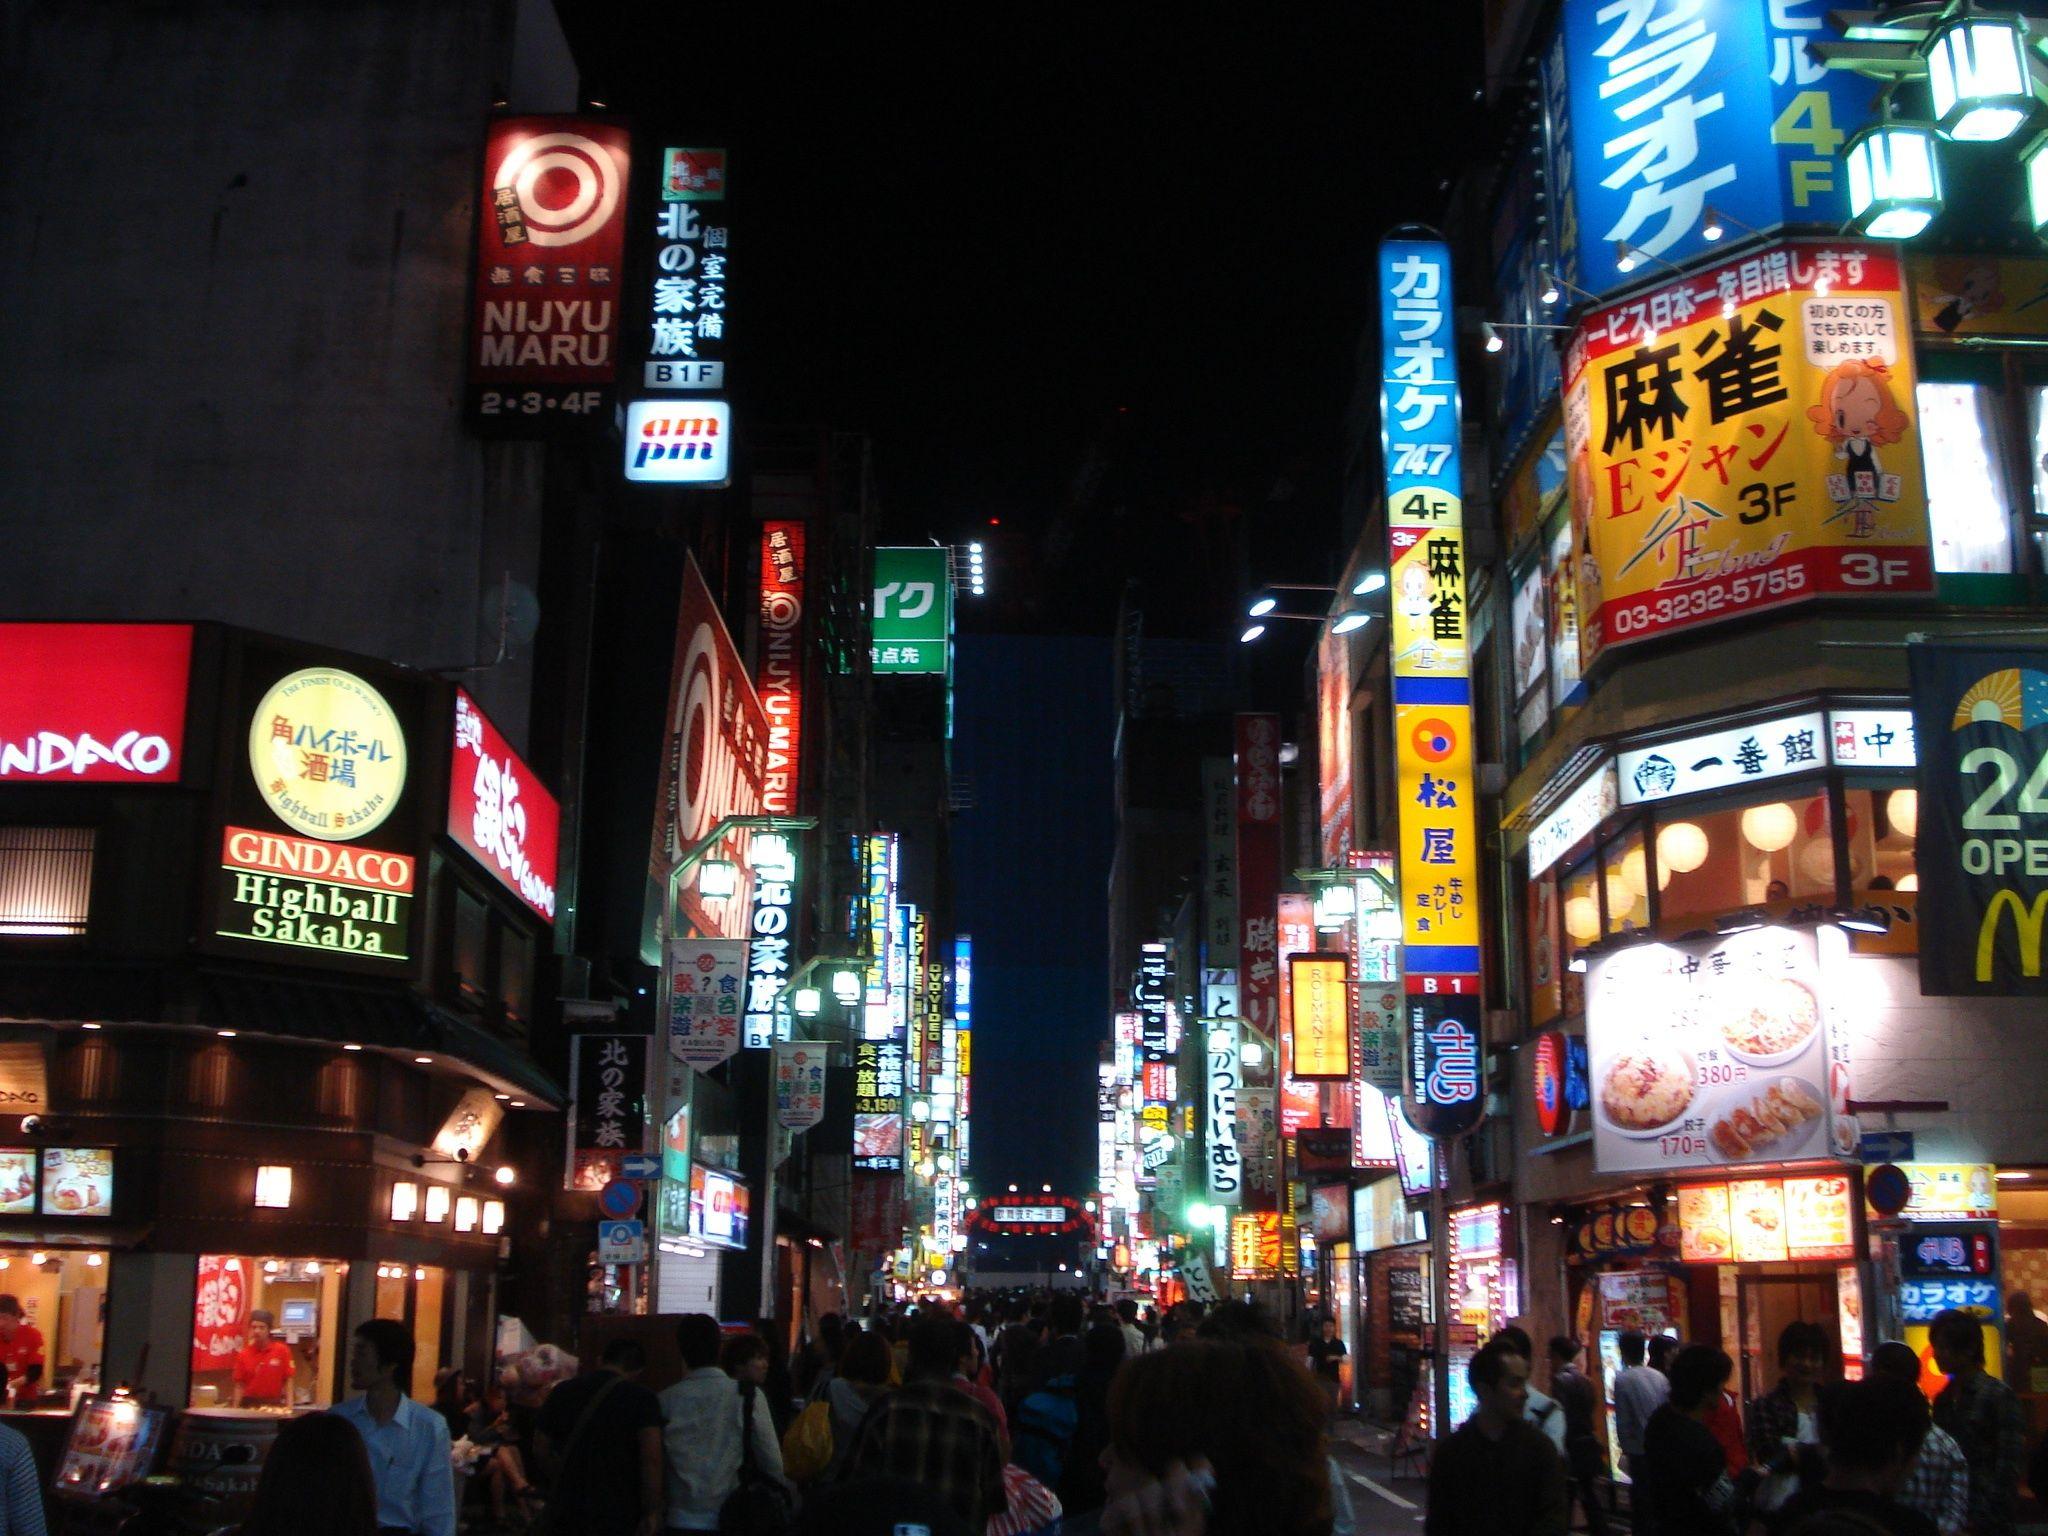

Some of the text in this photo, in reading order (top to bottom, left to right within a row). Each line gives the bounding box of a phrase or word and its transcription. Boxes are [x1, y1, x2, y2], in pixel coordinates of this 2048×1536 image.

[1771, 92, 1845, 207] 4F
[650, 203, 701, 357] 北の家族
[695, 227, 728, 340] 個室完備
[484, 300, 611, 333] NIJYU
[1808, 304, 1885, 320] 初めての方
[1810, 320, 1888, 338] でも安心して
[480, 334, 607, 367] MARU
[1391, 255, 1447, 432] カラオケ
[655, 364, 714, 383] B1F
[1602, 309, 1789, 457] 麻雀
[642, 417, 720, 438] am
[634, 441, 715, 468] pm
[1392, 443, 1453, 476] 747
[1605, 419, 1792, 520] Eジャン
[1402, 494, 1447, 520] 4F
[1738, 481, 1797, 527] 3F
[769, 531, 800, 584] 居酒屋
[1391, 531, 1418, 547] 3F
[1428, 537, 1462, 641] 麻雀
[1839, 552, 1910, 586] 3F
[1614, 562, 1807, 634] 03-3232-5755
[271, 714, 393, 763] 角ハイボール
[763, 631, 793, 812] NIJYU-MARU
[0, 730, 171, 774] NDACO
[299, 750, 357, 788] 酒場
[1690, 729, 1818, 778] 一番館
[1416, 772, 1457, 864] 松屋
[229, 833, 410, 888] GINDACO
[233, 872, 399, 925] Highball
[1416, 893, 1431, 932] 定食
[1433, 884, 1447, 926] カレー
[1448, 877, 1465, 919] 牛めし
[251, 909, 383, 955] Sakaba
[719, 973, 738, 994] 食
[856, 1042, 877, 1098] 食べ放題
[877, 1042, 904, 1098] 本格焼肉
[1413, 1007, 1428, 1105] THE ENGLISH PUB
[1427, 1018, 1479, 1106] HUB
[1698, 1064, 1748, 1085] 380円
[594, 1038, 630, 1148] 北の家族
[1660, 1135, 1707, 1156] 170円
[1684, 1118, 1706, 1132] 餃子
[1901, 1282, 1996, 1304] カラオケ
